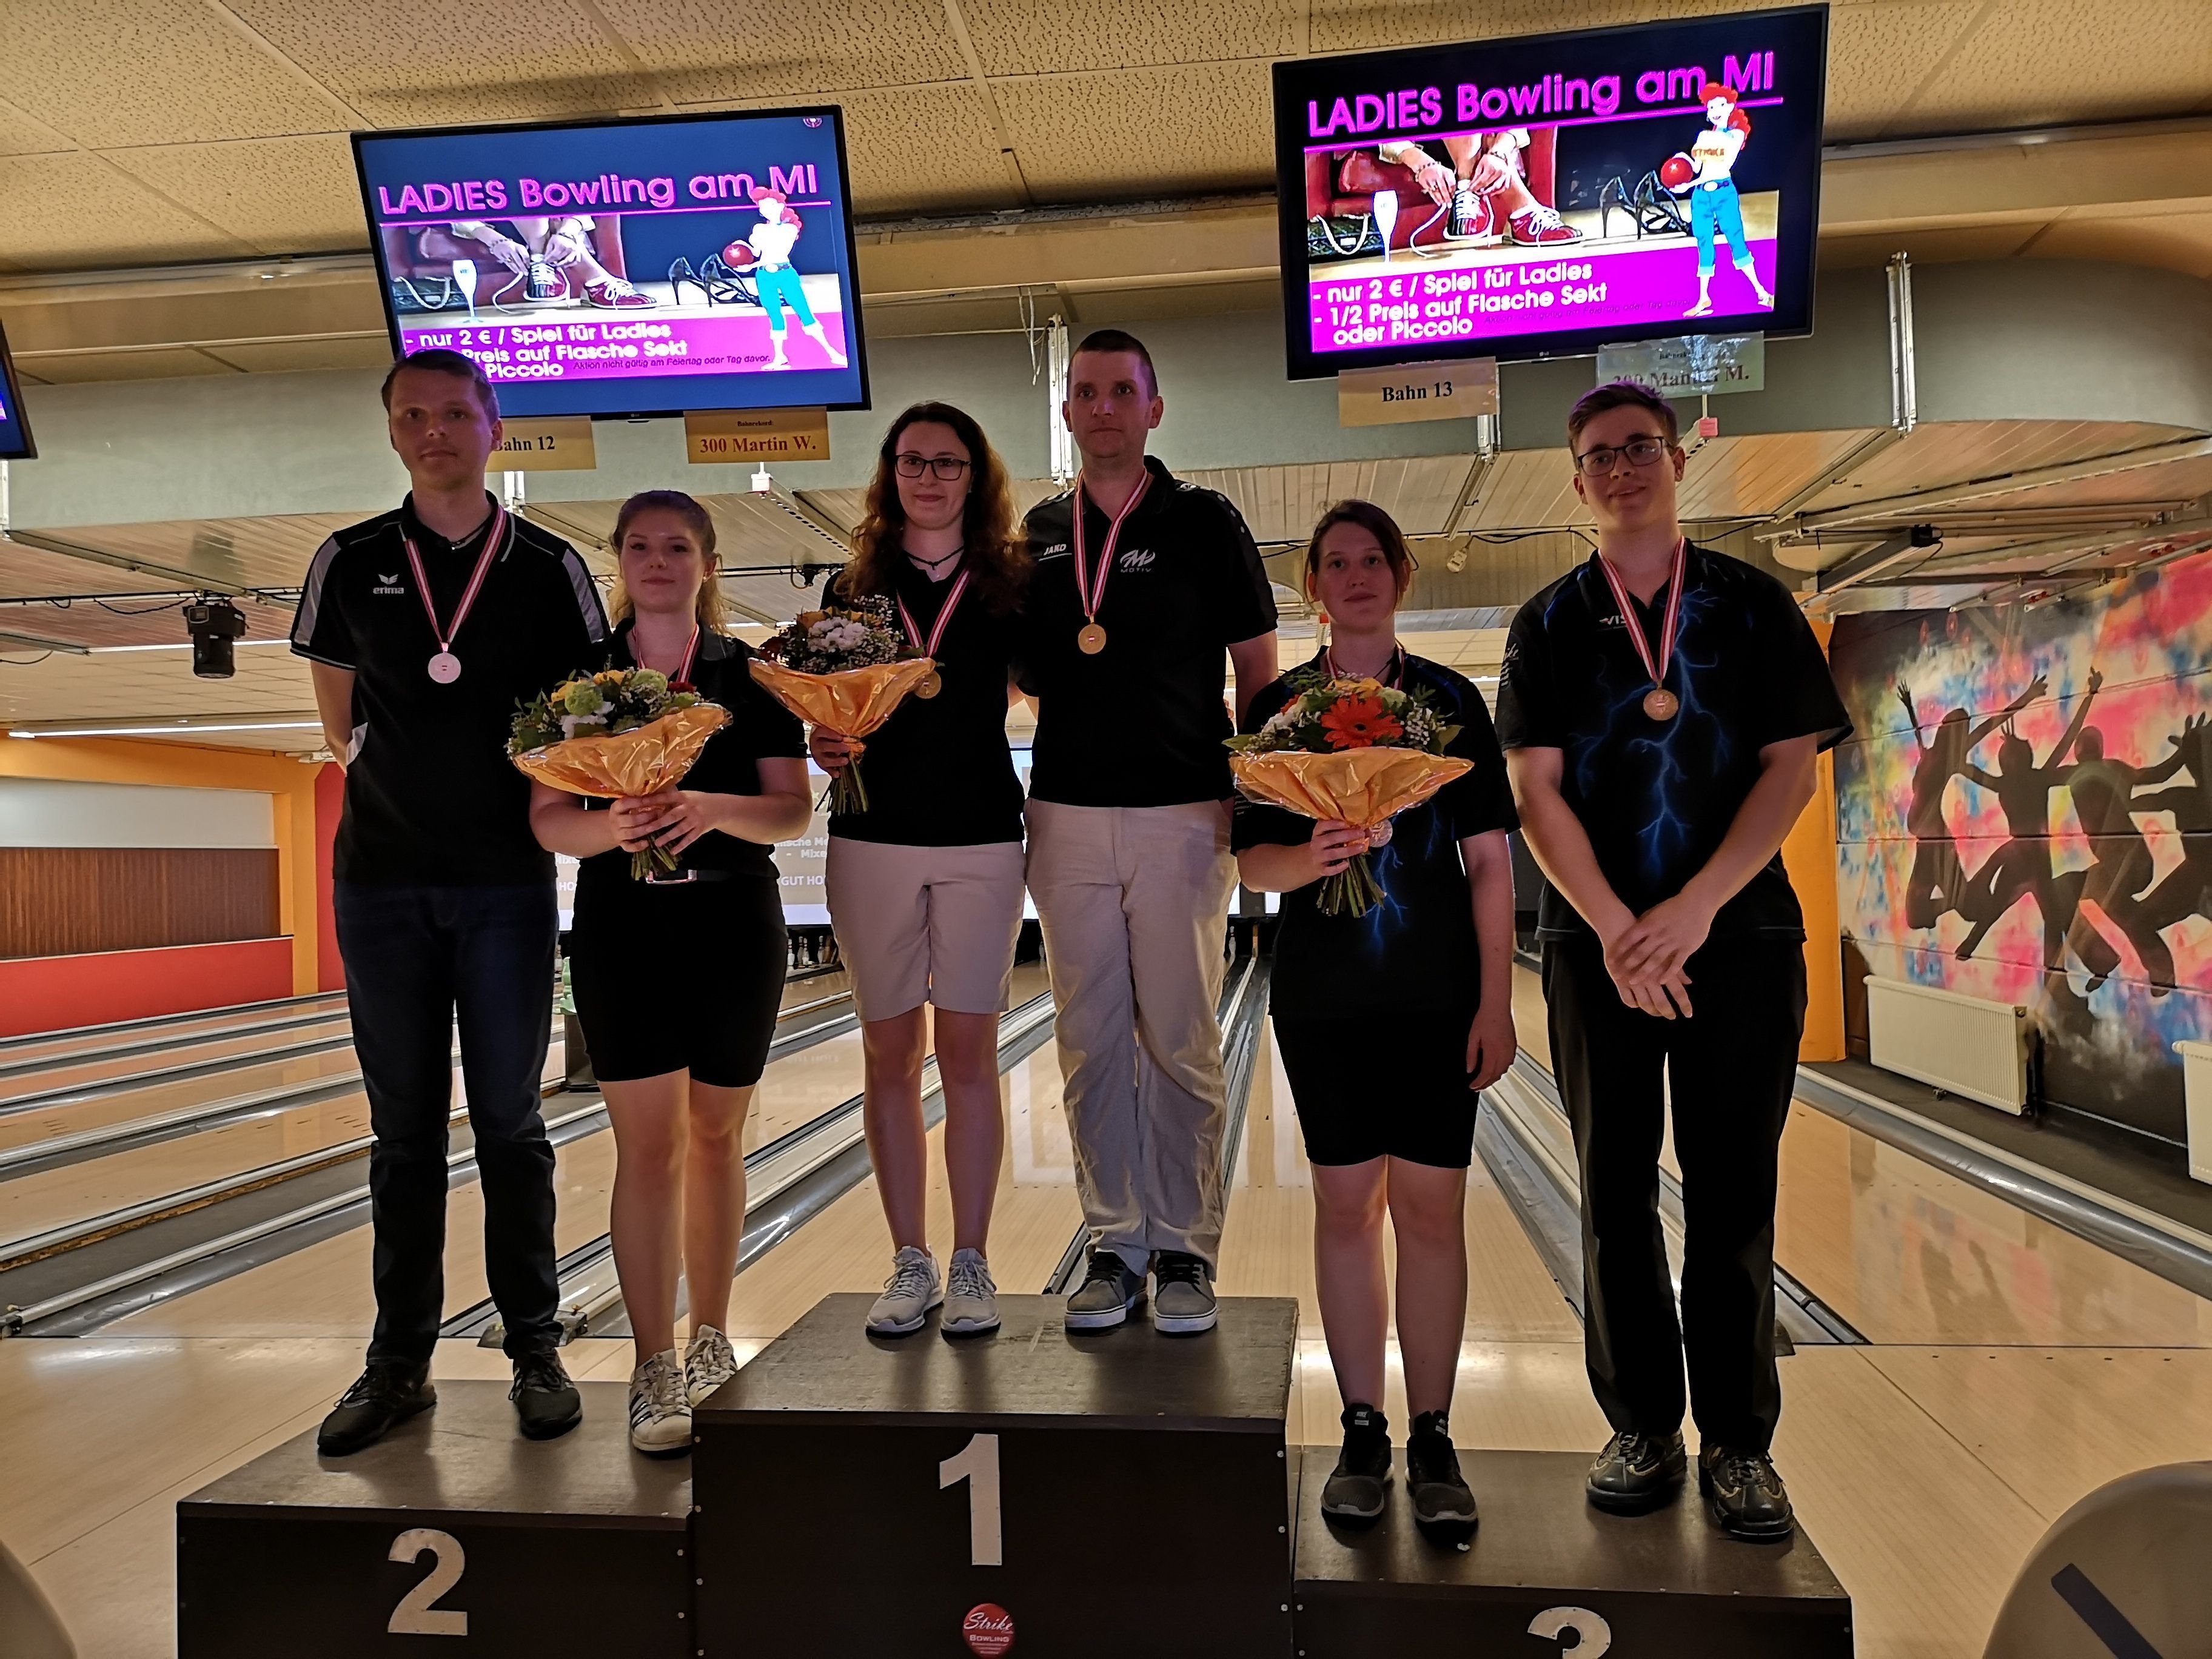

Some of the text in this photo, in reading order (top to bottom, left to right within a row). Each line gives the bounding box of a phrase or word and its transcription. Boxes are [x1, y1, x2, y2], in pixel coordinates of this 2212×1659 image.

[1308, 50, 1774, 137] LADIES Bowling am MI
[378, 164, 817, 215] LADIES Bowling am MI
[1327, 285, 1363, 303] nur
[1369, 279, 1383, 300] 2
[1389, 278, 1403, 297] €
[1409, 275, 1419, 297] /
[1423, 270, 1477, 298] Spiel
[1484, 267, 1513, 289] für
[1519, 261, 1592, 286] Ladies
[1330, 304, 1362, 327] 1/2
[1369, 300, 1419, 323] Preis
[1425, 295, 1462, 318] auf
[1468, 289, 1555, 314] Flasche
[1560, 282, 1607, 306] Sekt
[419, 333, 454, 347] nur
[458, 330, 473, 346] 2
[478, 330, 492, 344] €
[497, 327, 506, 346] /
[511, 326, 563, 346] Spiel
[567, 324, 597, 341] für
[601, 323, 672, 341] Ladies
[1333, 315, 1473, 345] oder Piccolo
[515, 345, 550, 362] auf
[555, 343, 638, 362] Flasche
[643, 340, 688, 357] Sekt
[726, 355, 742, 364] Tag
[484, 361, 563, 378] Piccolo
[1382, 381, 1453, 402] Bahn 13
[497, 435, 555, 451] ahn 12
[700, 435, 816, 453] 300 Martin W.
[1044, 543, 1067, 556] JAKO
[372, 586, 404, 594] erima
[781, 876, 805, 886] GUT
[939, 1433, 1002, 1566] 1
[387, 1527, 468, 1636] 2
[964, 1612, 1013, 1631] Strike
